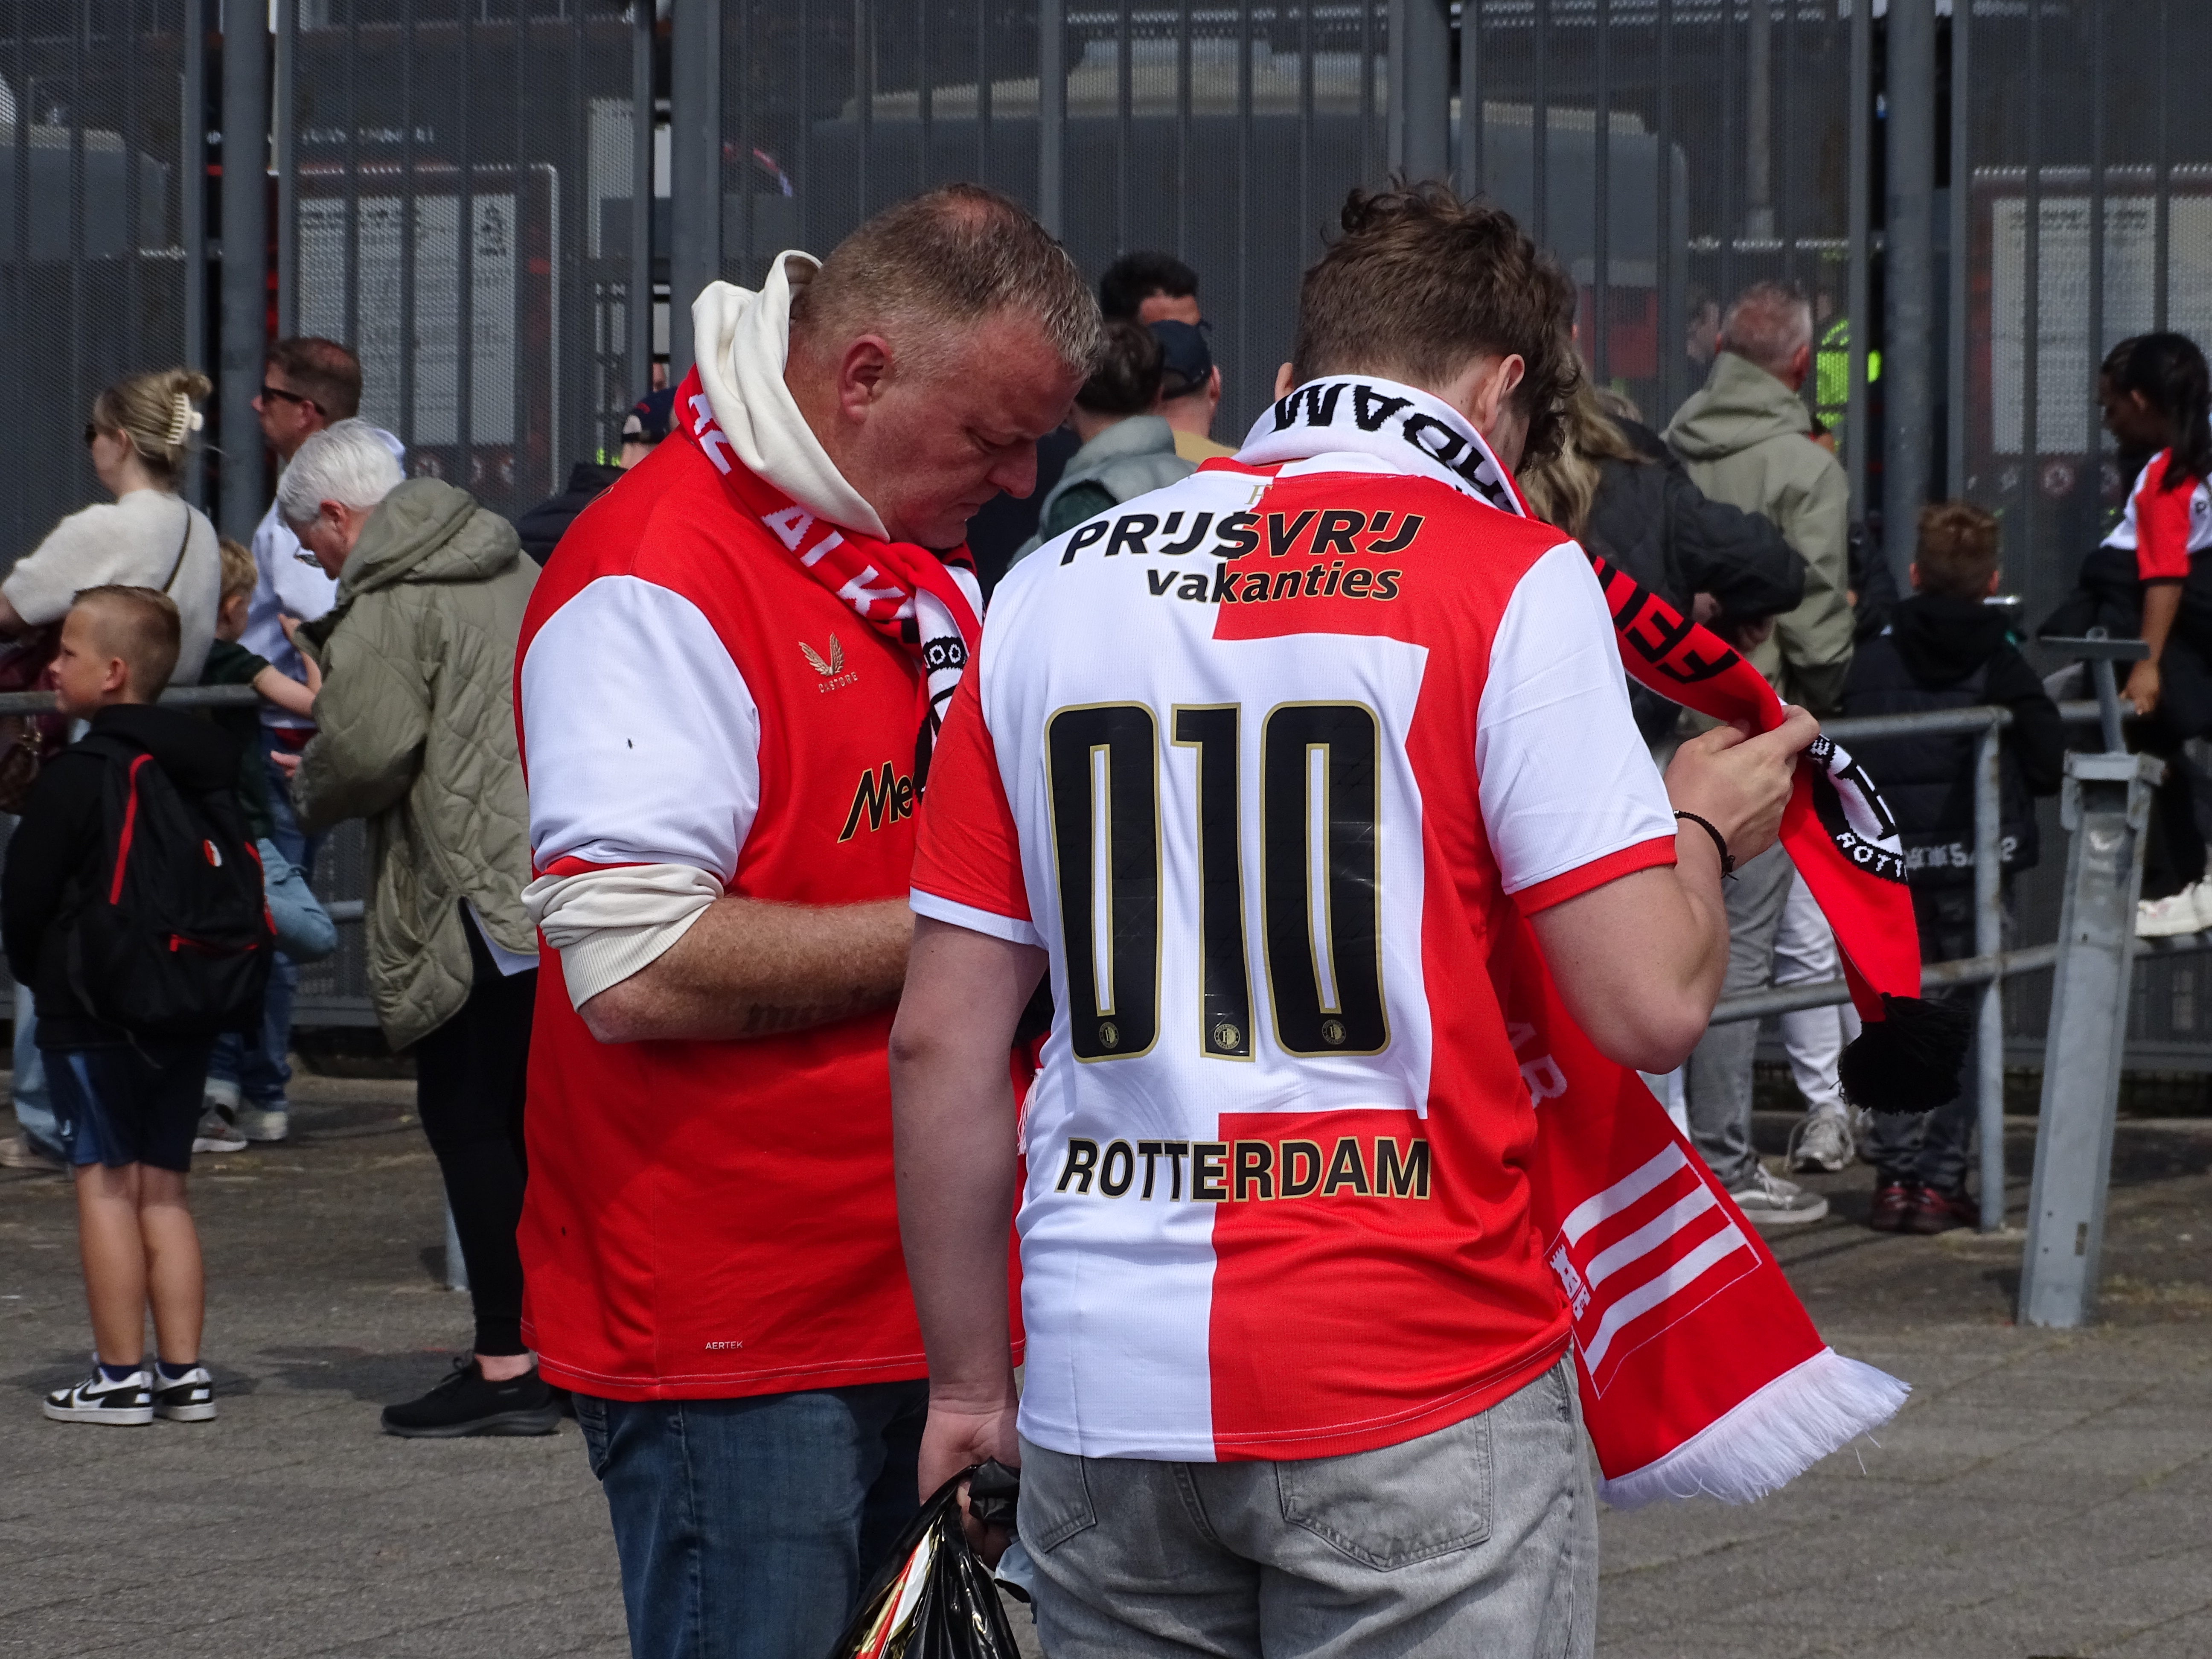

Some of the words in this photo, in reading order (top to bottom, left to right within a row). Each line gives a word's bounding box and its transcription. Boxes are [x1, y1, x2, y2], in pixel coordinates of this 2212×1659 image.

[1146, 560, 1403, 603] vakanties
[923, 643, 966, 669] OO
[837, 760, 914, 844] Me
[1045, 701, 1391, 1063] 010
[1054, 1136, 1431, 1202] ROTTERDAM
[705, 1340, 743, 1350] AERTEK
